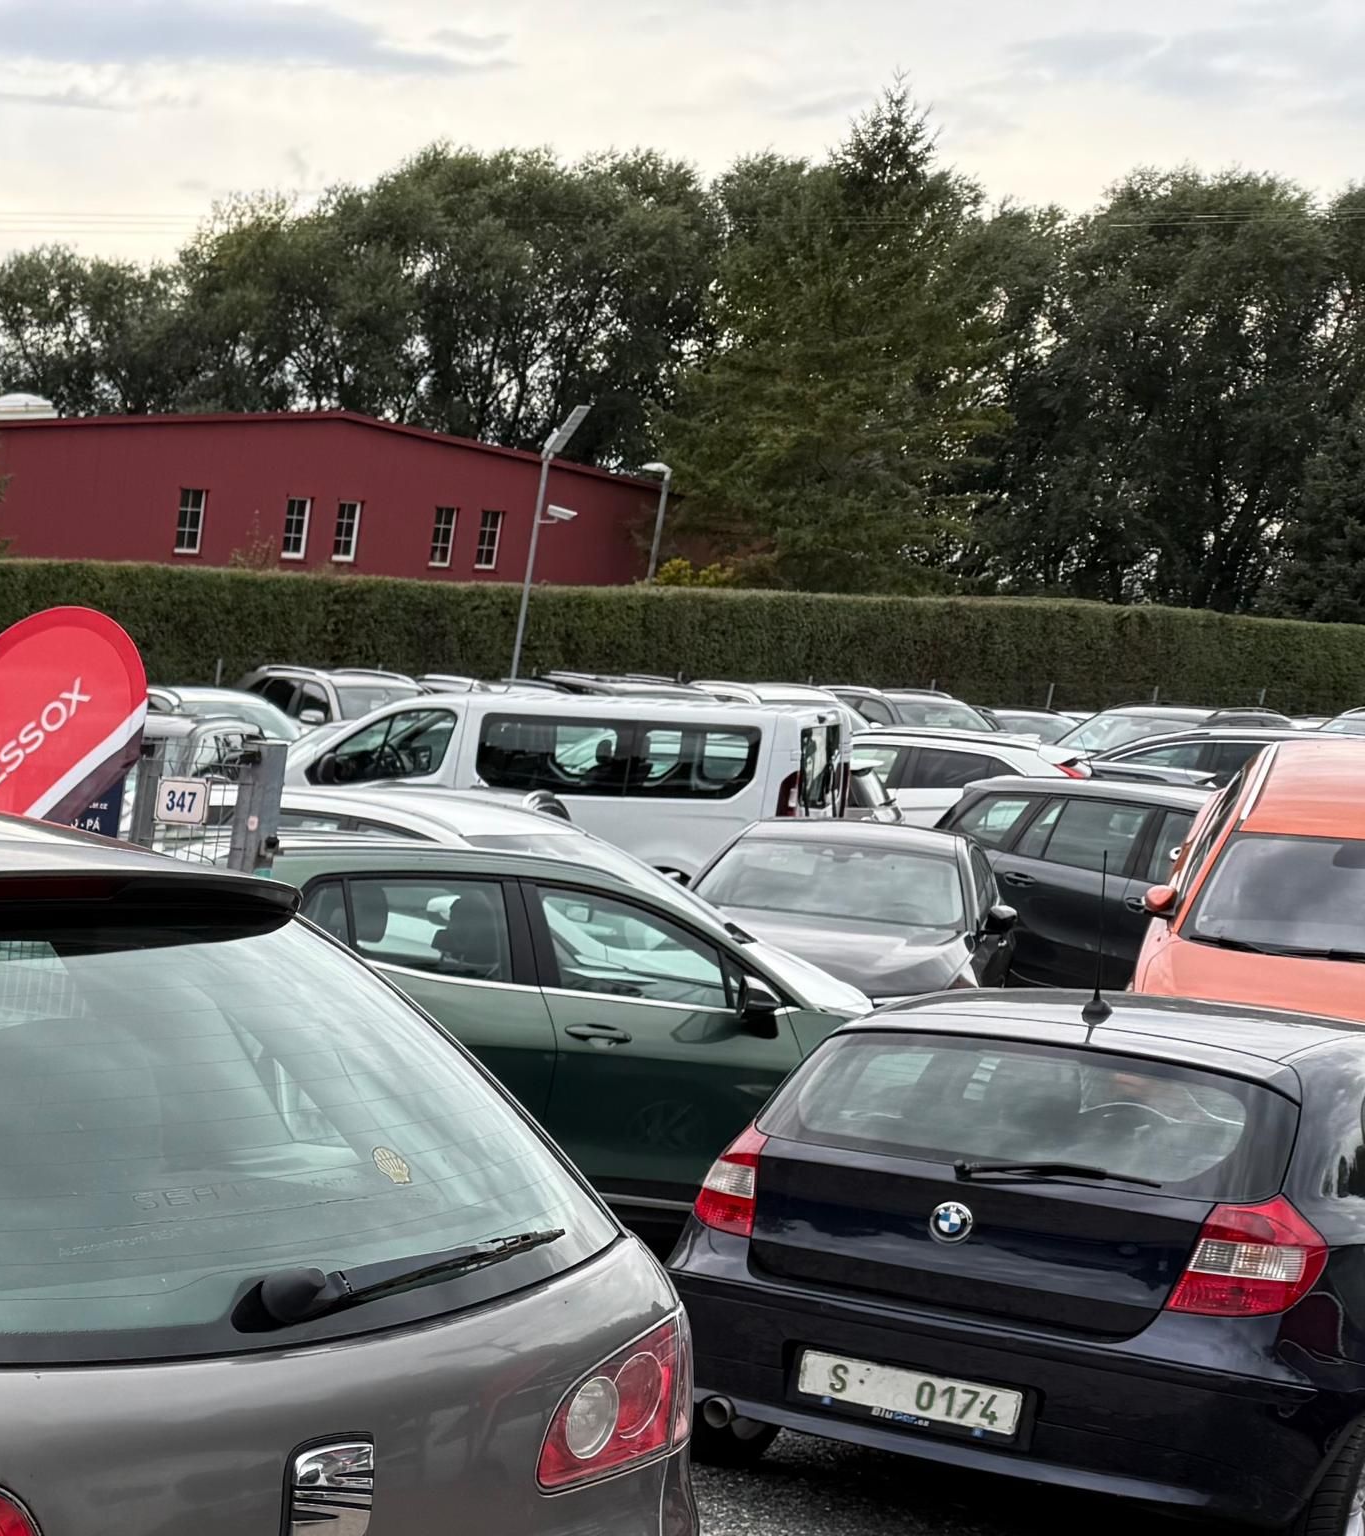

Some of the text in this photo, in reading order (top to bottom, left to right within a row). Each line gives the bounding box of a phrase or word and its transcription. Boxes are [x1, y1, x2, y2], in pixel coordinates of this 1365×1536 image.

[165, 789, 198, 814] 347
[828, 1363, 998, 1426] S 0174
